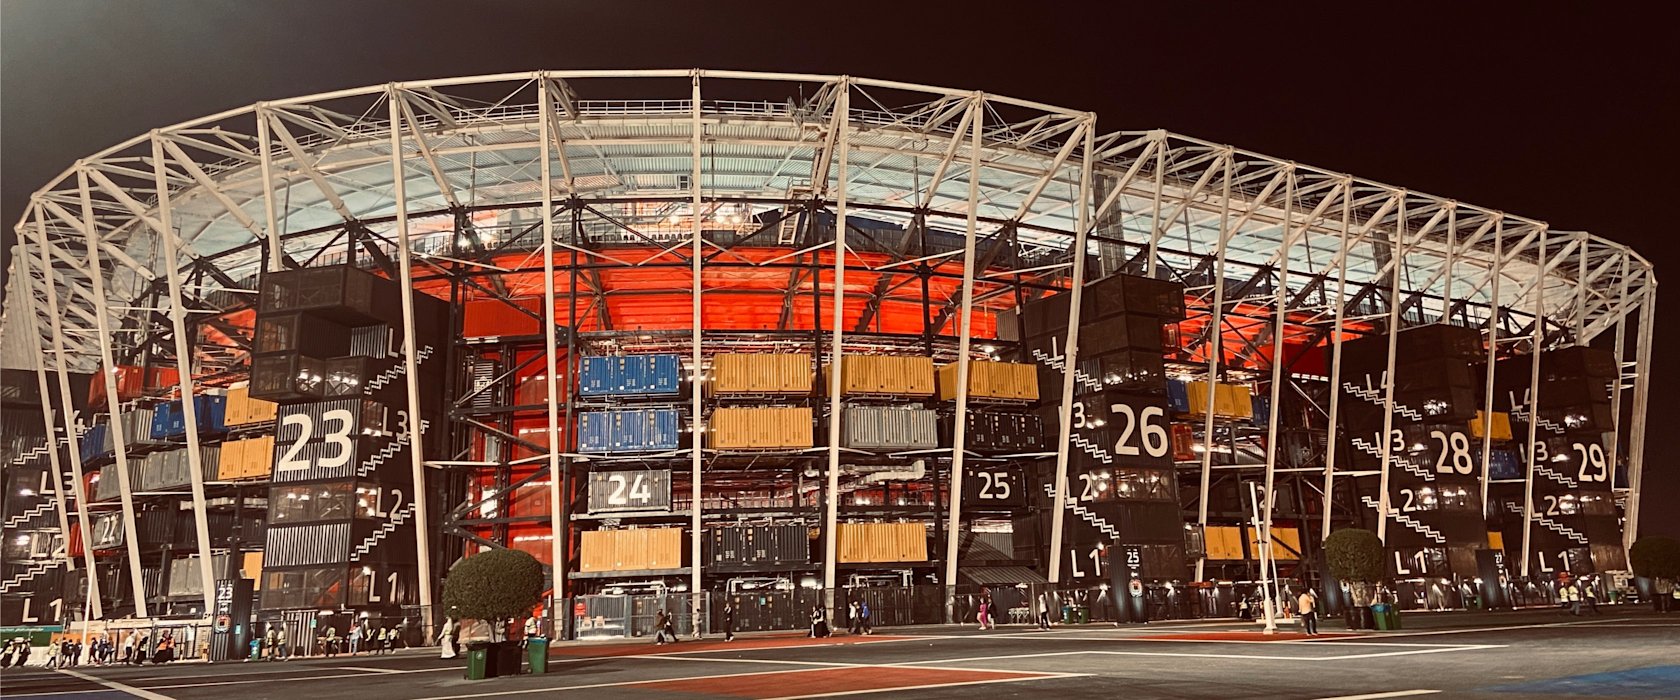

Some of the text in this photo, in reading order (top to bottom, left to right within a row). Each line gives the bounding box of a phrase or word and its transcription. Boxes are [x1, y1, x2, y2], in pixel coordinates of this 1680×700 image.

[382, 406, 408, 440] L3
[1111, 404, 1168, 458] 26
[278, 409, 353, 472] 23
[1431, 431, 1473, 475] 28
[1573, 443, 1607, 482] 29
[607, 474, 651, 505] 24
[978, 472, 1011, 499] 25
[376, 487, 404, 519] L2
[102, 515, 118, 543] 22
[1071, 549, 1101, 577] L1
[1127, 551, 1140, 563] 25
[1395, 550, 1427, 574] L1
[1539, 550, 1571, 572] L1
[217, 587, 233, 600] 23
[368, 570, 398, 604] L1
[22, 598, 63, 622] L1
